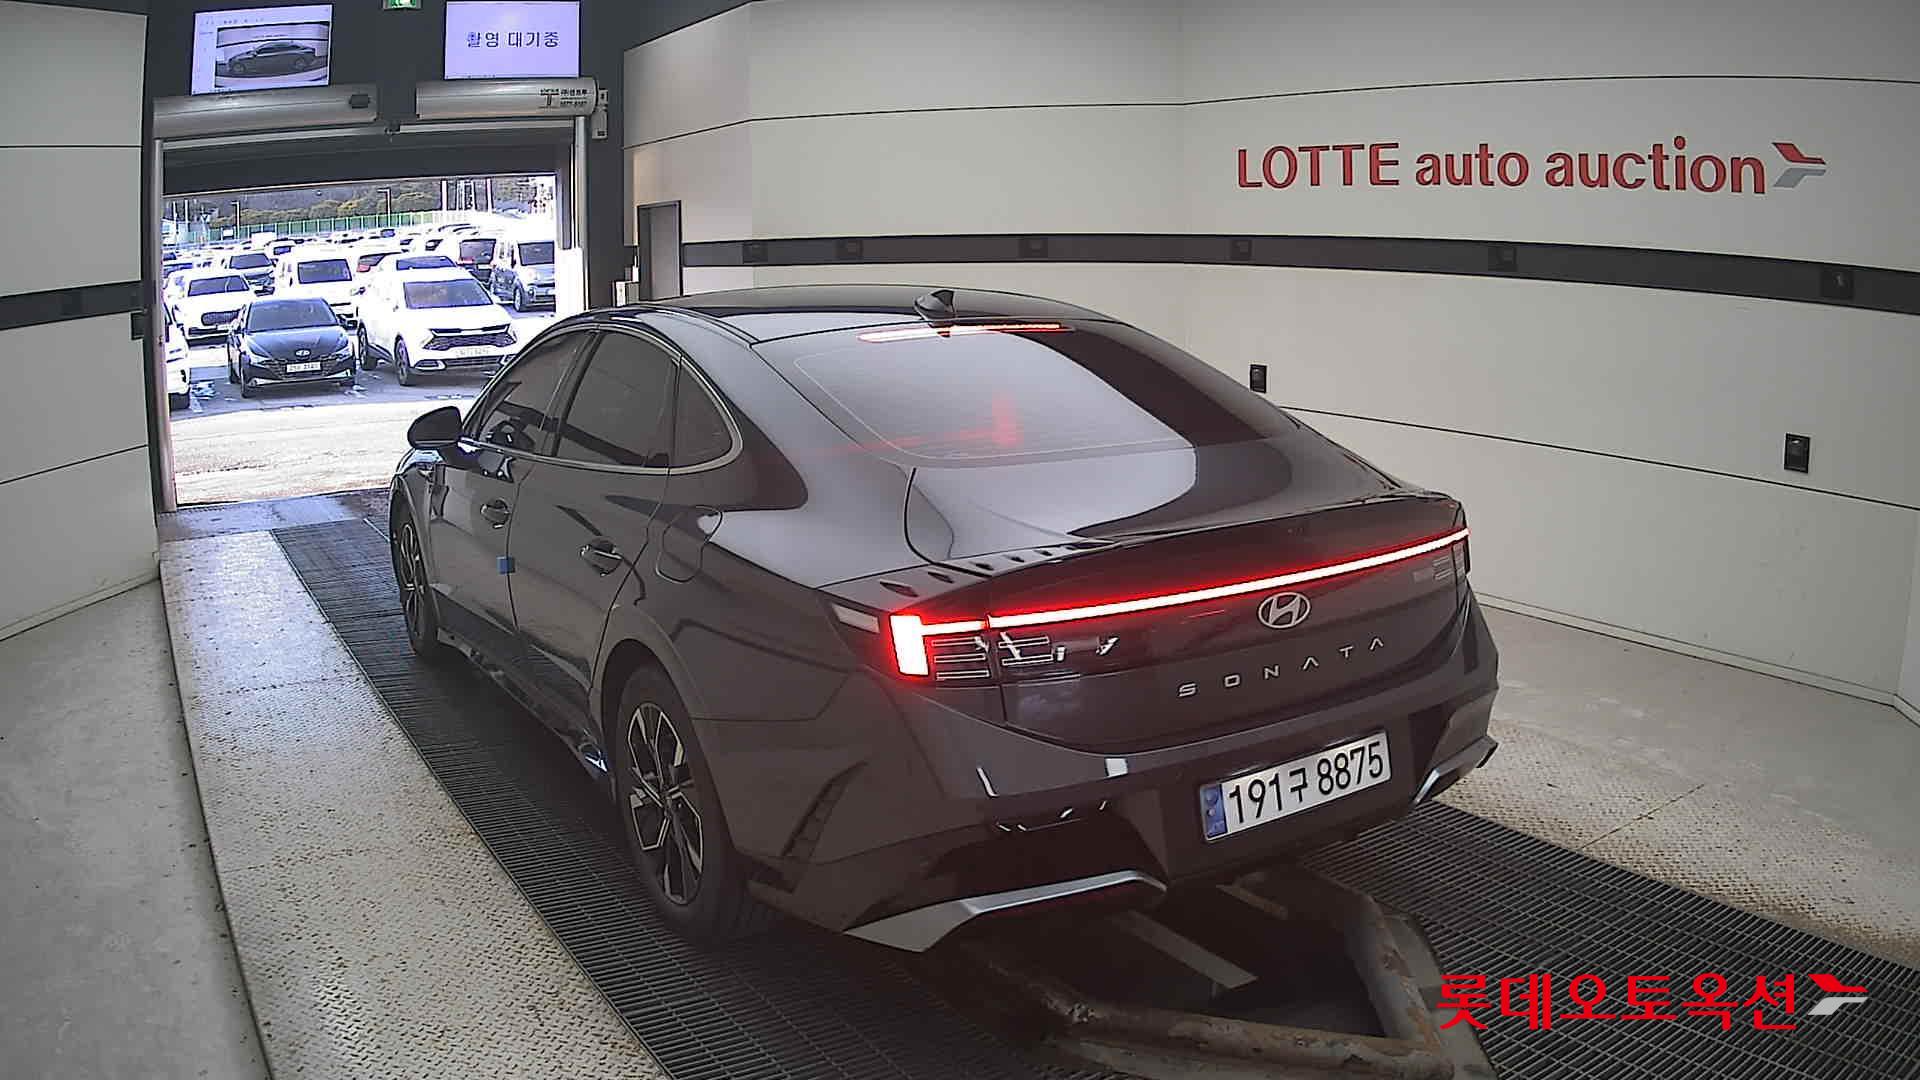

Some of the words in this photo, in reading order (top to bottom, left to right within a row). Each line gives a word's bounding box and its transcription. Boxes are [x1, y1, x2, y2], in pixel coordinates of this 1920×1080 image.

[508, 31, 560, 48] 대기중
[1237, 142, 1400, 188] LOTTE
[1415, 143, 1529, 187] auto
[1545, 136, 1766, 194] auction
[1178, 637, 1384, 698] SONATA
[1229, 767, 1308, 823] 191구
[1317, 741, 1384, 796] 8875
